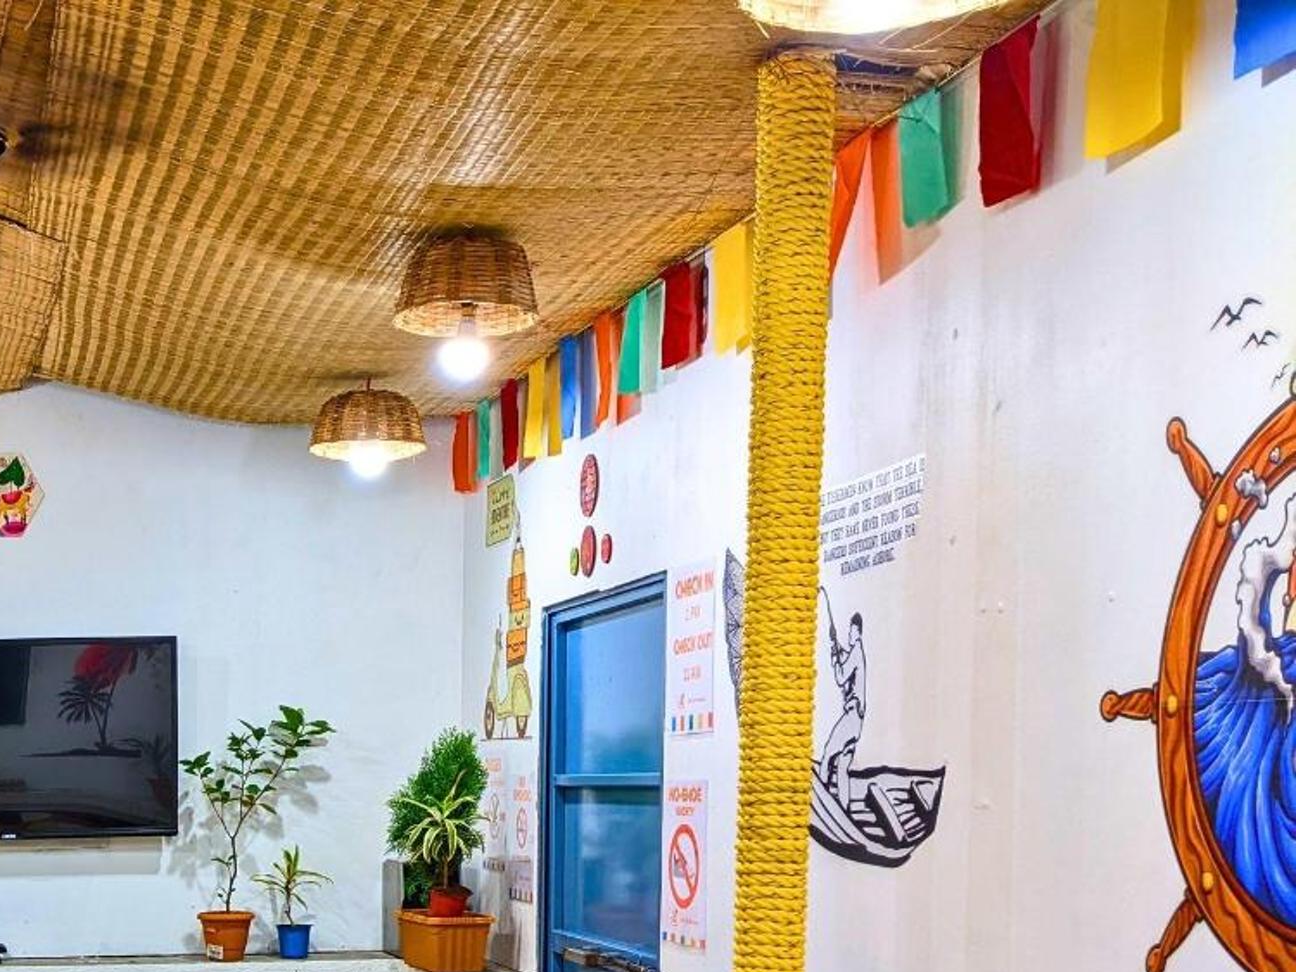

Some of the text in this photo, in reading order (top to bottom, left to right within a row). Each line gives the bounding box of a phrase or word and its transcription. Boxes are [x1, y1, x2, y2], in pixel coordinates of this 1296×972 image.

[675, 572, 714, 600] CHECK IN
[674, 631, 713, 656] CHECK OUT
